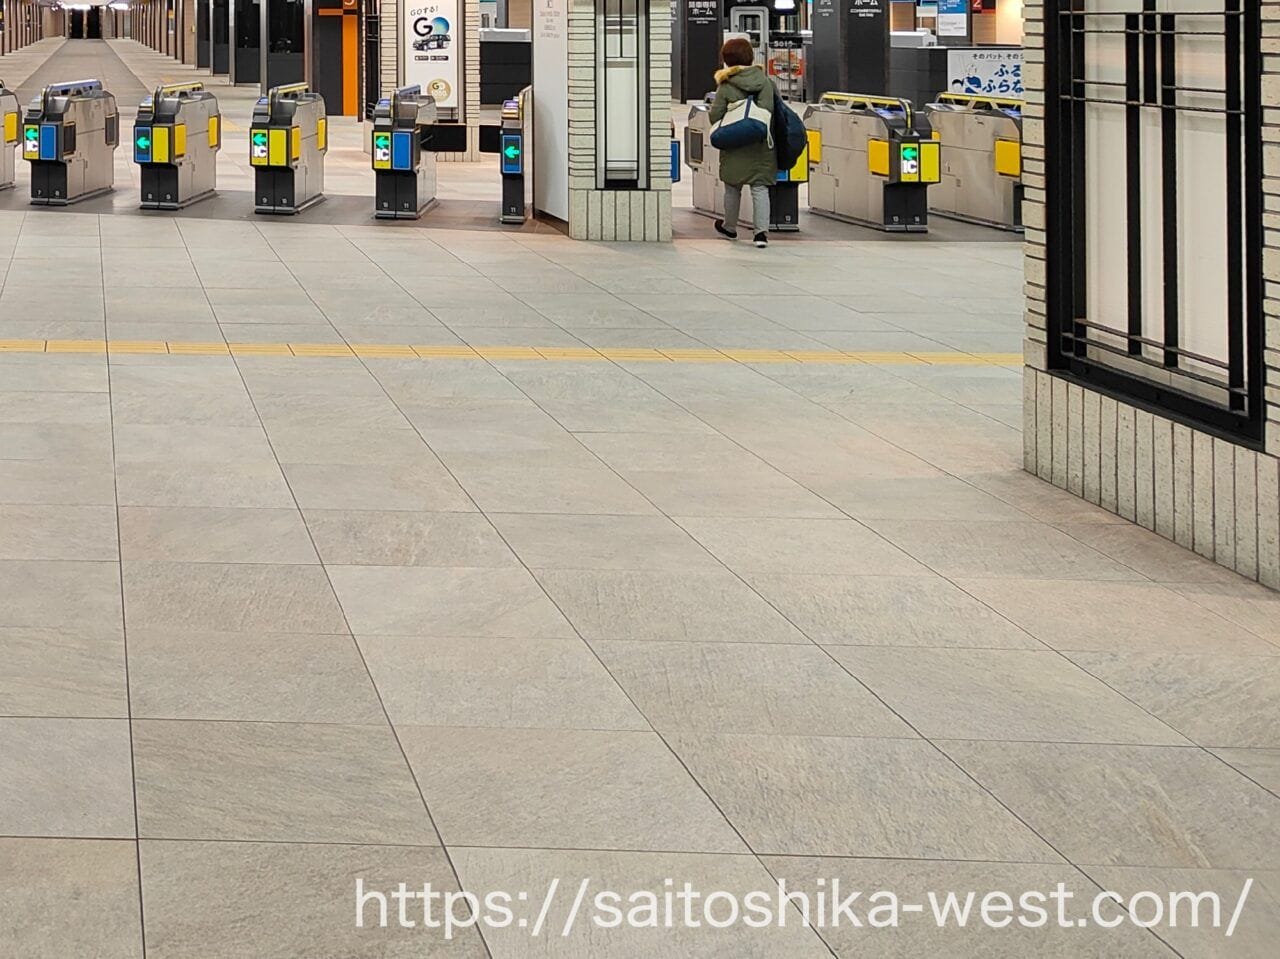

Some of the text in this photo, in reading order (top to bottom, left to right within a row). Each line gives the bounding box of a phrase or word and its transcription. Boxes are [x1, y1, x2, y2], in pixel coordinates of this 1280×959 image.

[692, 7, 713, 15] ホーム
[413, 16, 450, 37] GO
[252, 145, 268, 159] IC
[375, 147, 390, 161] IC
[902, 159, 918, 173] IC
